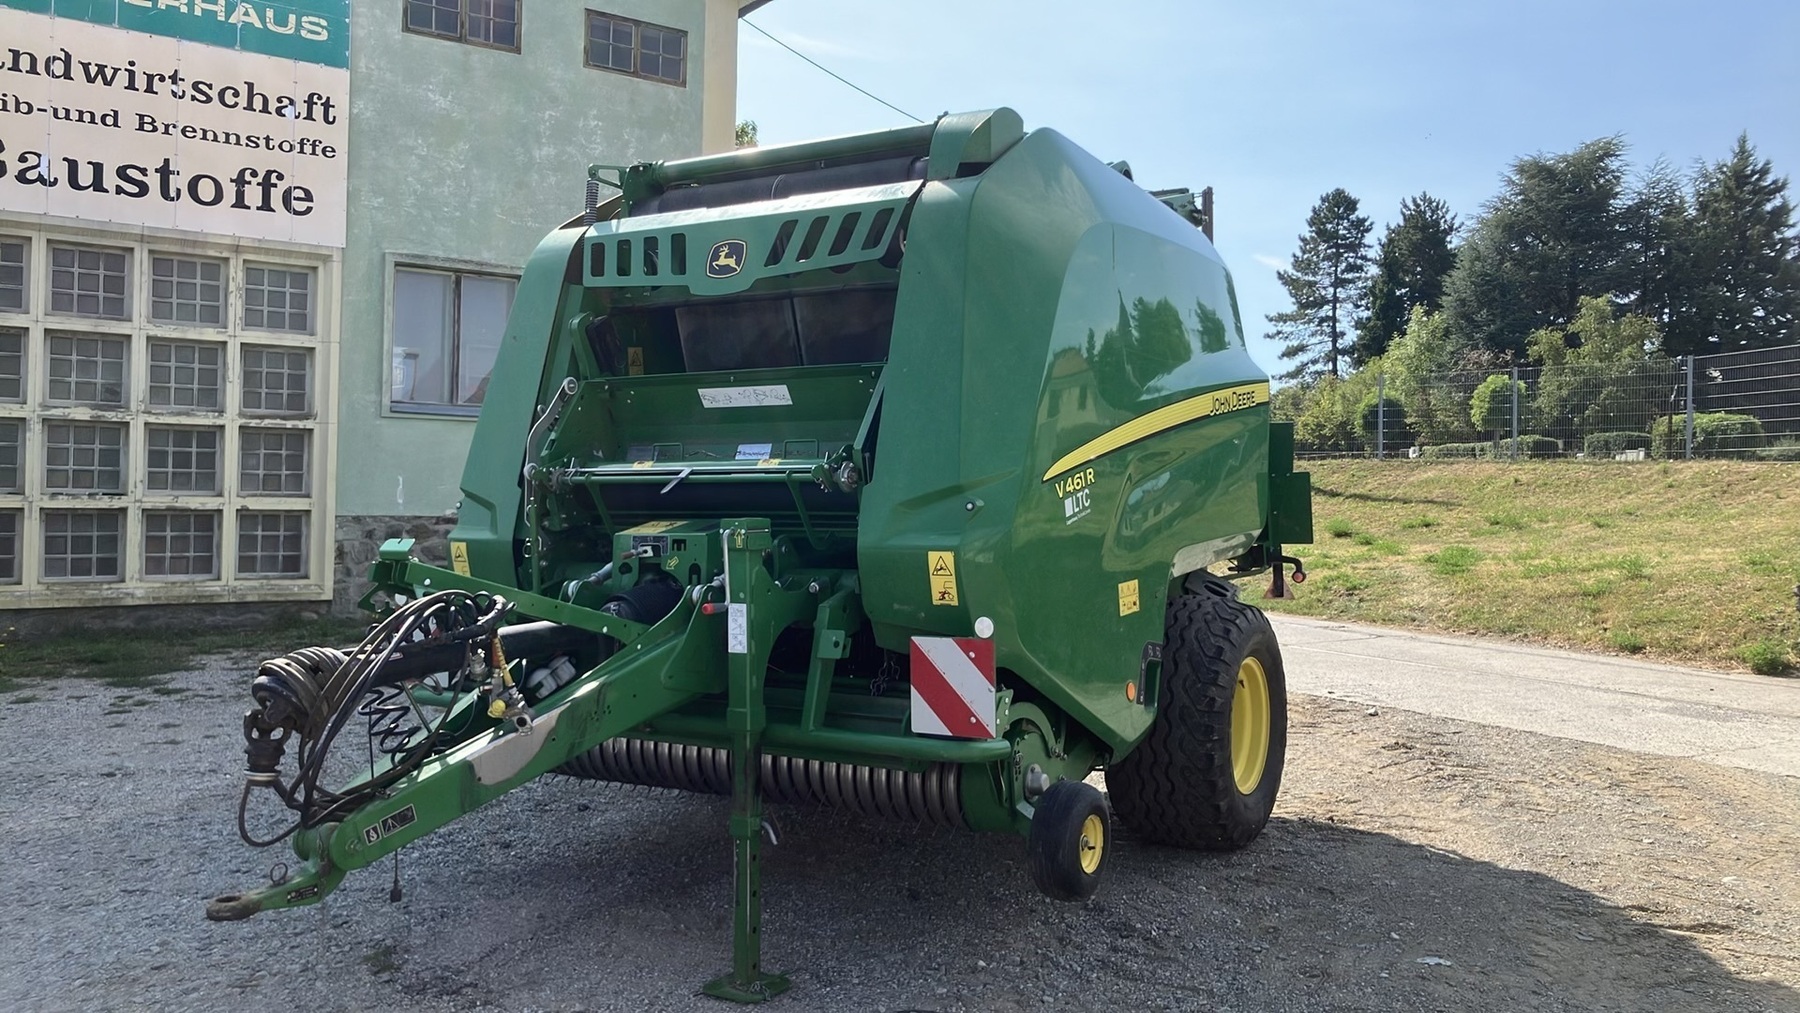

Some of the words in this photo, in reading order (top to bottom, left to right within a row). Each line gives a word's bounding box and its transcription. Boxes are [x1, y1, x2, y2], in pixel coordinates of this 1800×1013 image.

[0, 48, 337, 125] ndwirtschaft
[135, 113, 337, 158] Brennstoffe
[1072, 488, 1091, 513] LTC
